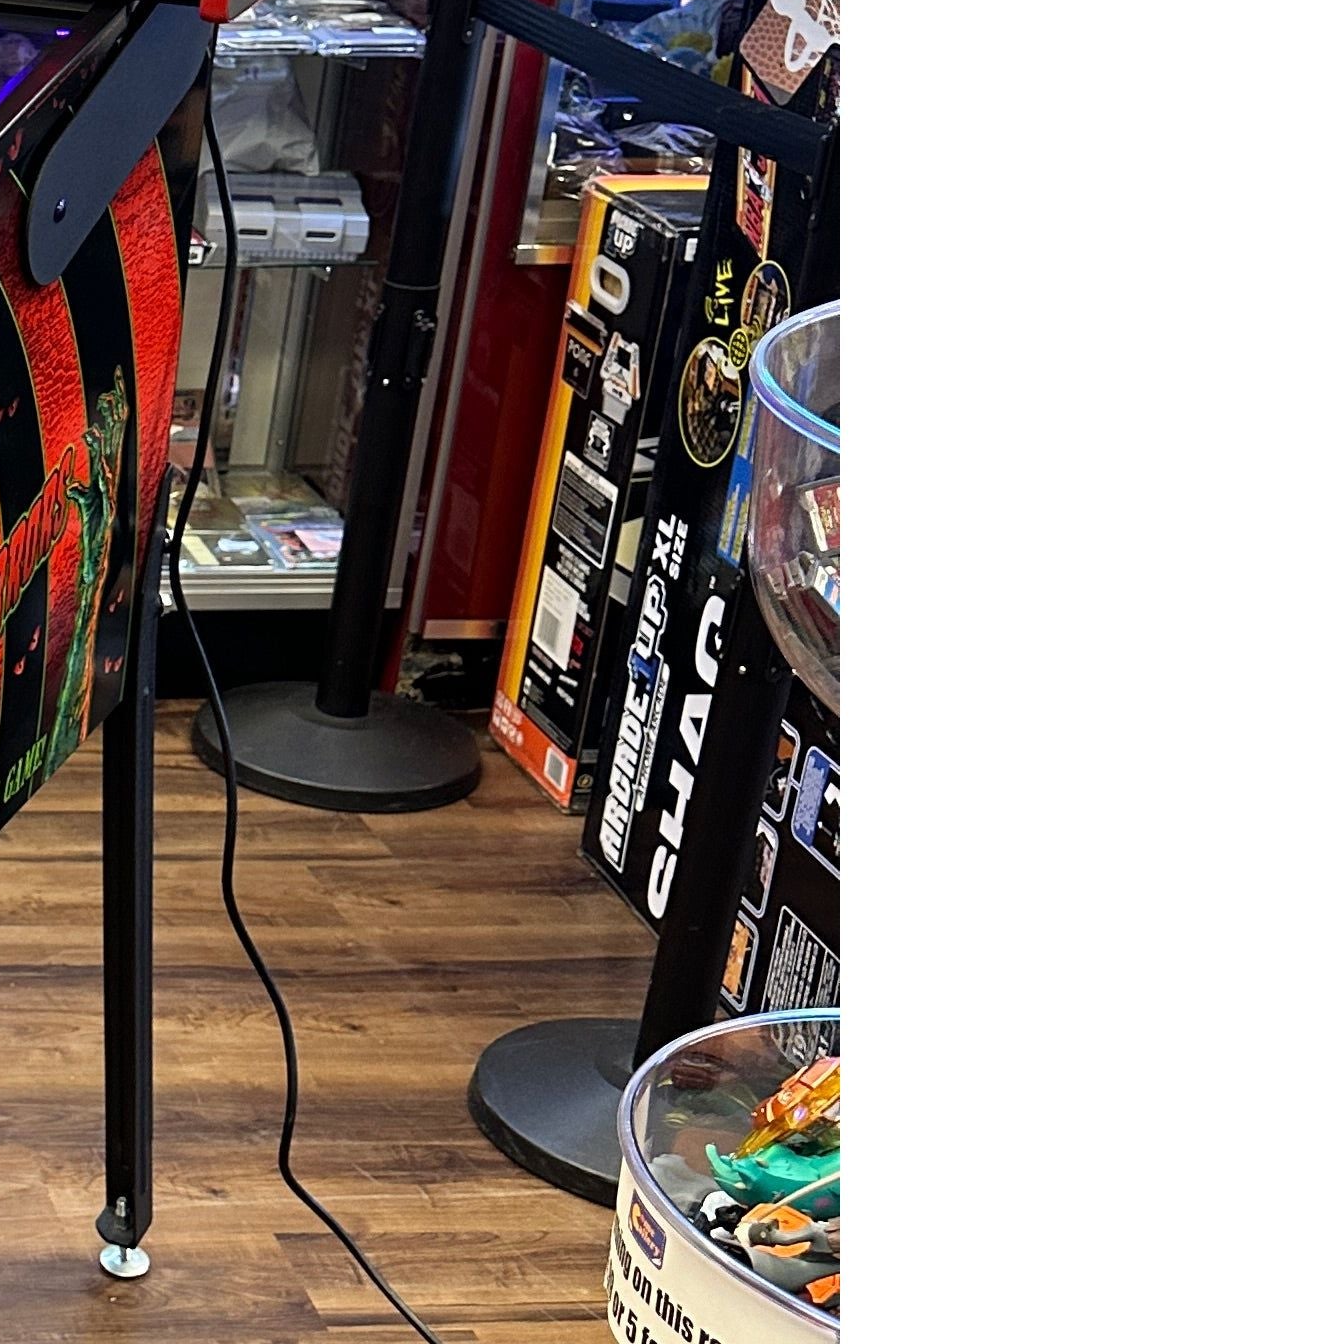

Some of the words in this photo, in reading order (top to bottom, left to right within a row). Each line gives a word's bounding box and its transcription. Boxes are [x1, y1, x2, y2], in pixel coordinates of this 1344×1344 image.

[614, 230, 634, 253] UP
[651, 513, 677, 573] XL
[669, 518, 689, 581] SIZE
[2, 733, 49, 804] GAME!
[612, 1289, 625, 1327] or
[625, 1310, 637, 1344] 5
[632, 1263, 652, 1307] on
[655, 1288, 694, 1343] this
